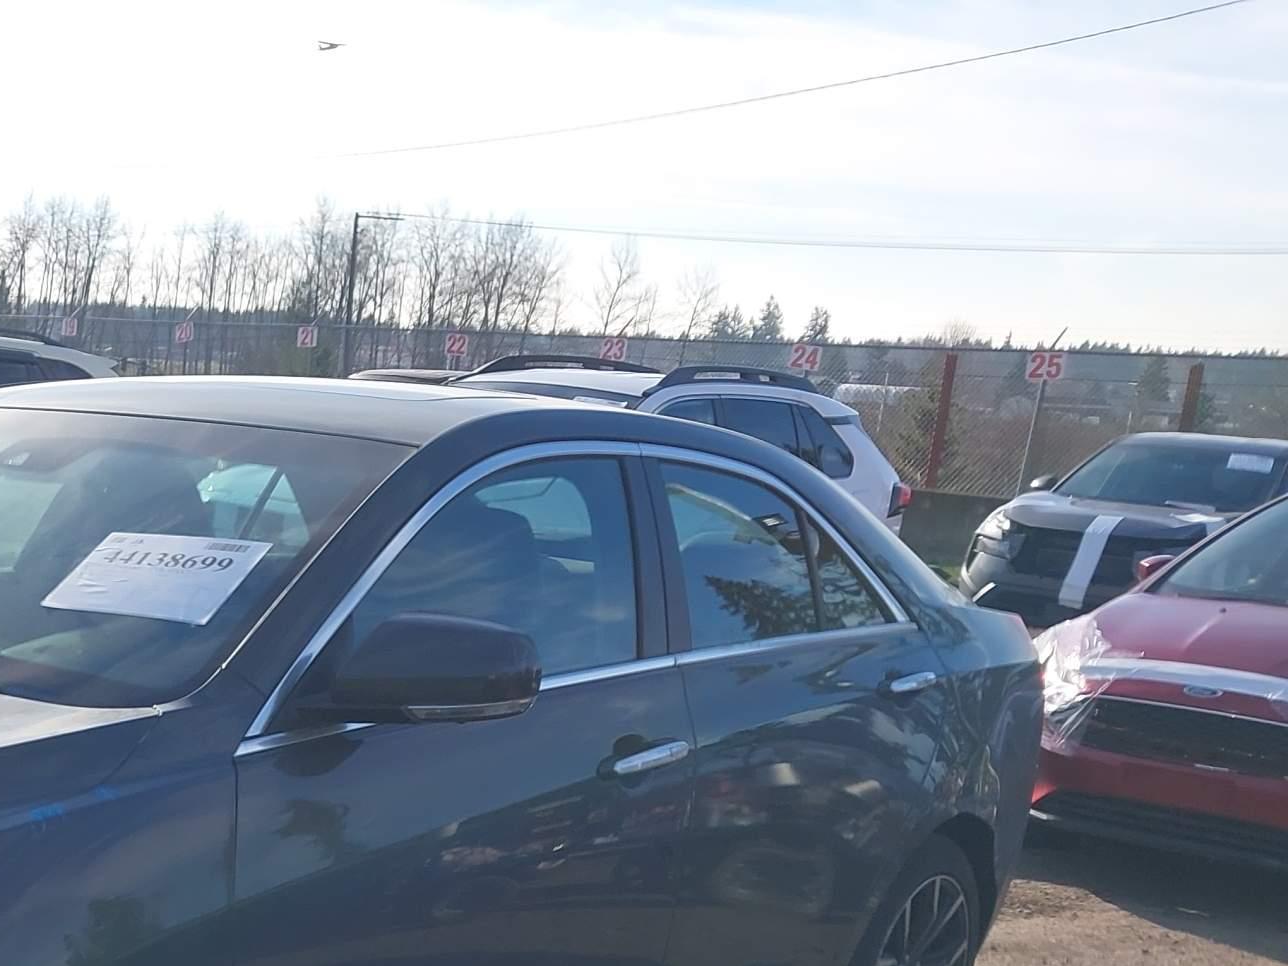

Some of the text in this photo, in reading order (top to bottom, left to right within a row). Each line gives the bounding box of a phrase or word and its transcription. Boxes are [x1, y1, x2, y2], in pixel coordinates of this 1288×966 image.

[177, 323, 192, 340] 20
[300, 328, 314, 346] 21
[446, 335, 467, 355] 22
[600, 337, 626, 360] 23
[791, 345, 818, 369] 24
[1028, 353, 1063, 380] 25
[103, 548, 235, 573] 44138699
